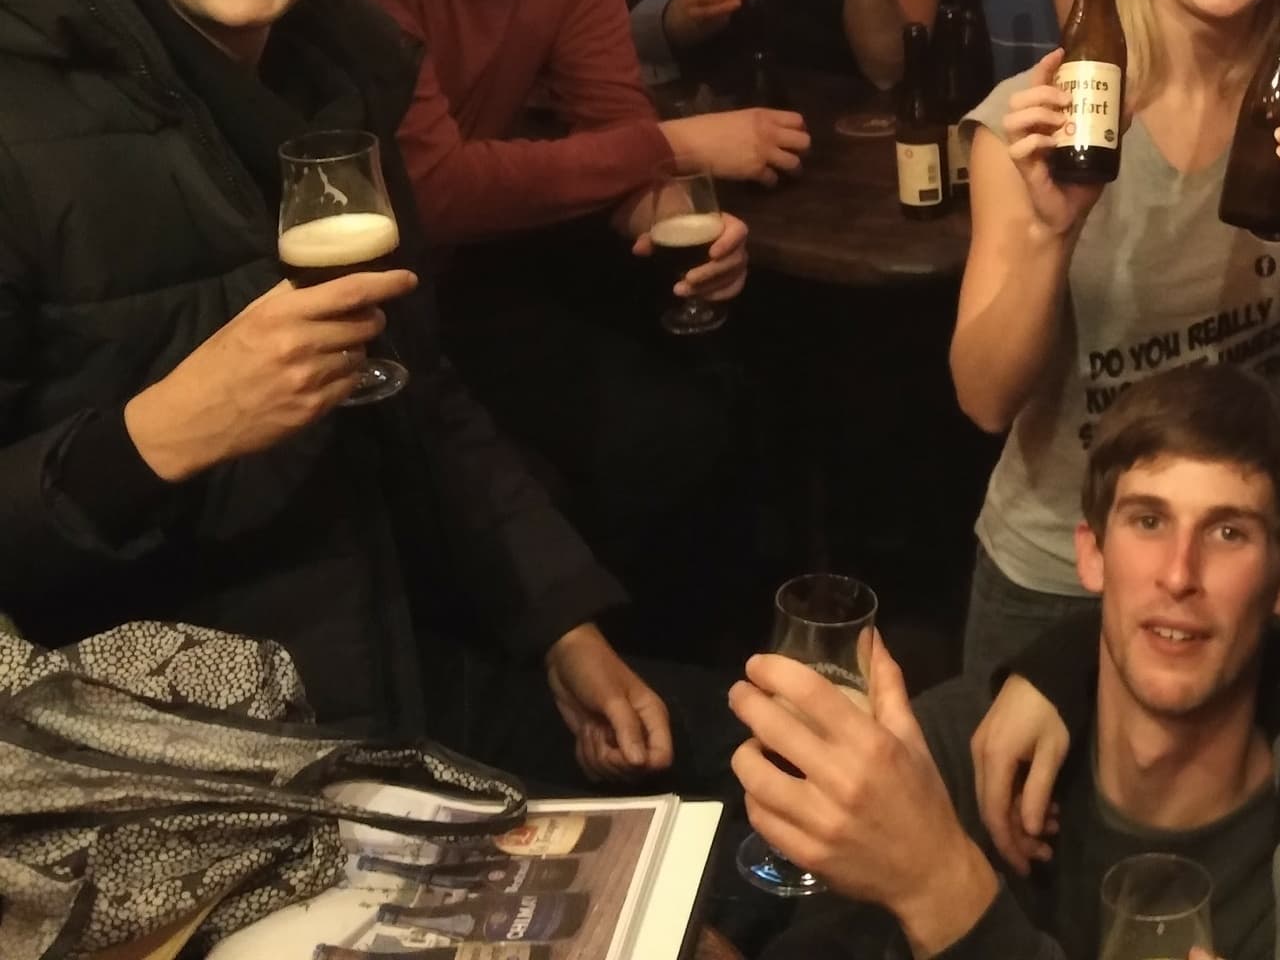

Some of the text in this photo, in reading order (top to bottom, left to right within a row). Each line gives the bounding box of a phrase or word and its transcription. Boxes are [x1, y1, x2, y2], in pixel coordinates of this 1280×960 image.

[1089, 349, 1124, 380] DO
[1129, 332, 1181, 370] YOU
[1188, 297, 1274, 351] REALLY
